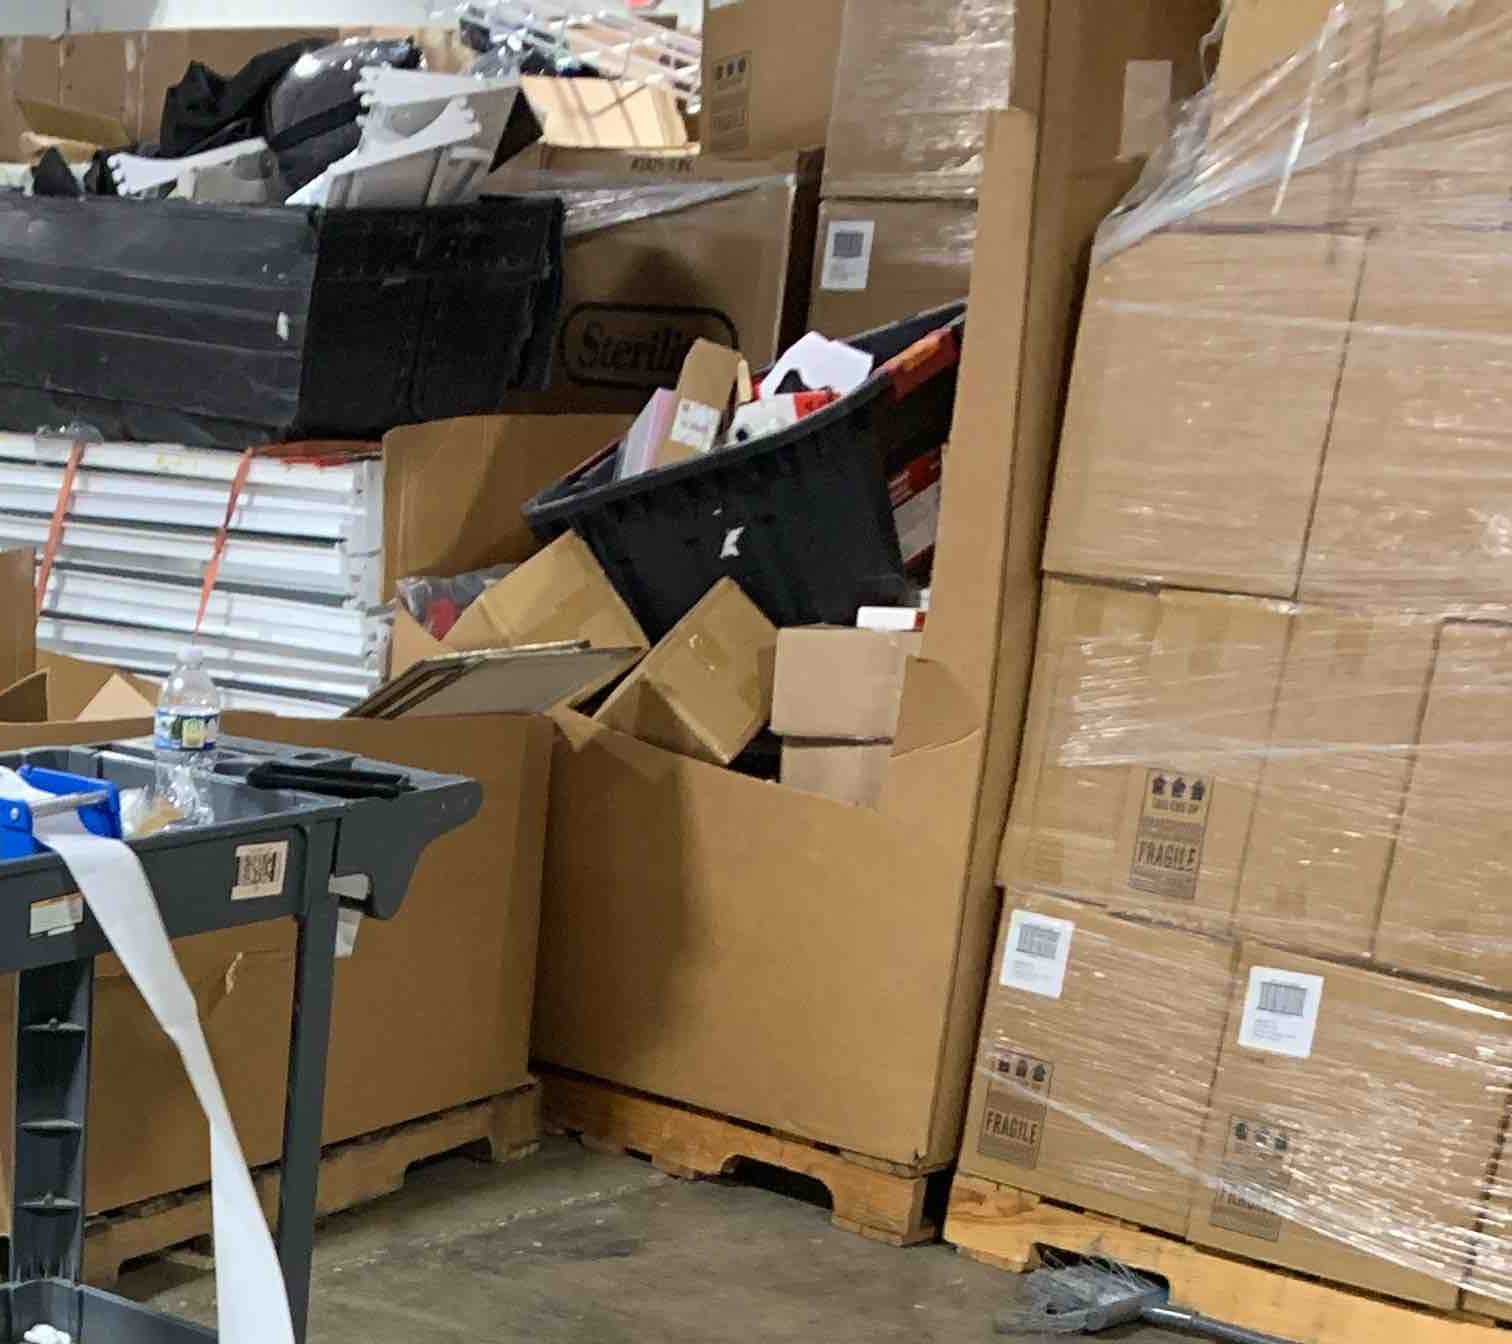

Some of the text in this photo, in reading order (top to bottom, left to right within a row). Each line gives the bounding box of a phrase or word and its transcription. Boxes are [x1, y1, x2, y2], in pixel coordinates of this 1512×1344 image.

[580, 321, 686, 371] Sterili
[1137, 840, 1197, 872] FRAGILE
[986, 1110, 1039, 1145] FRAGILE
